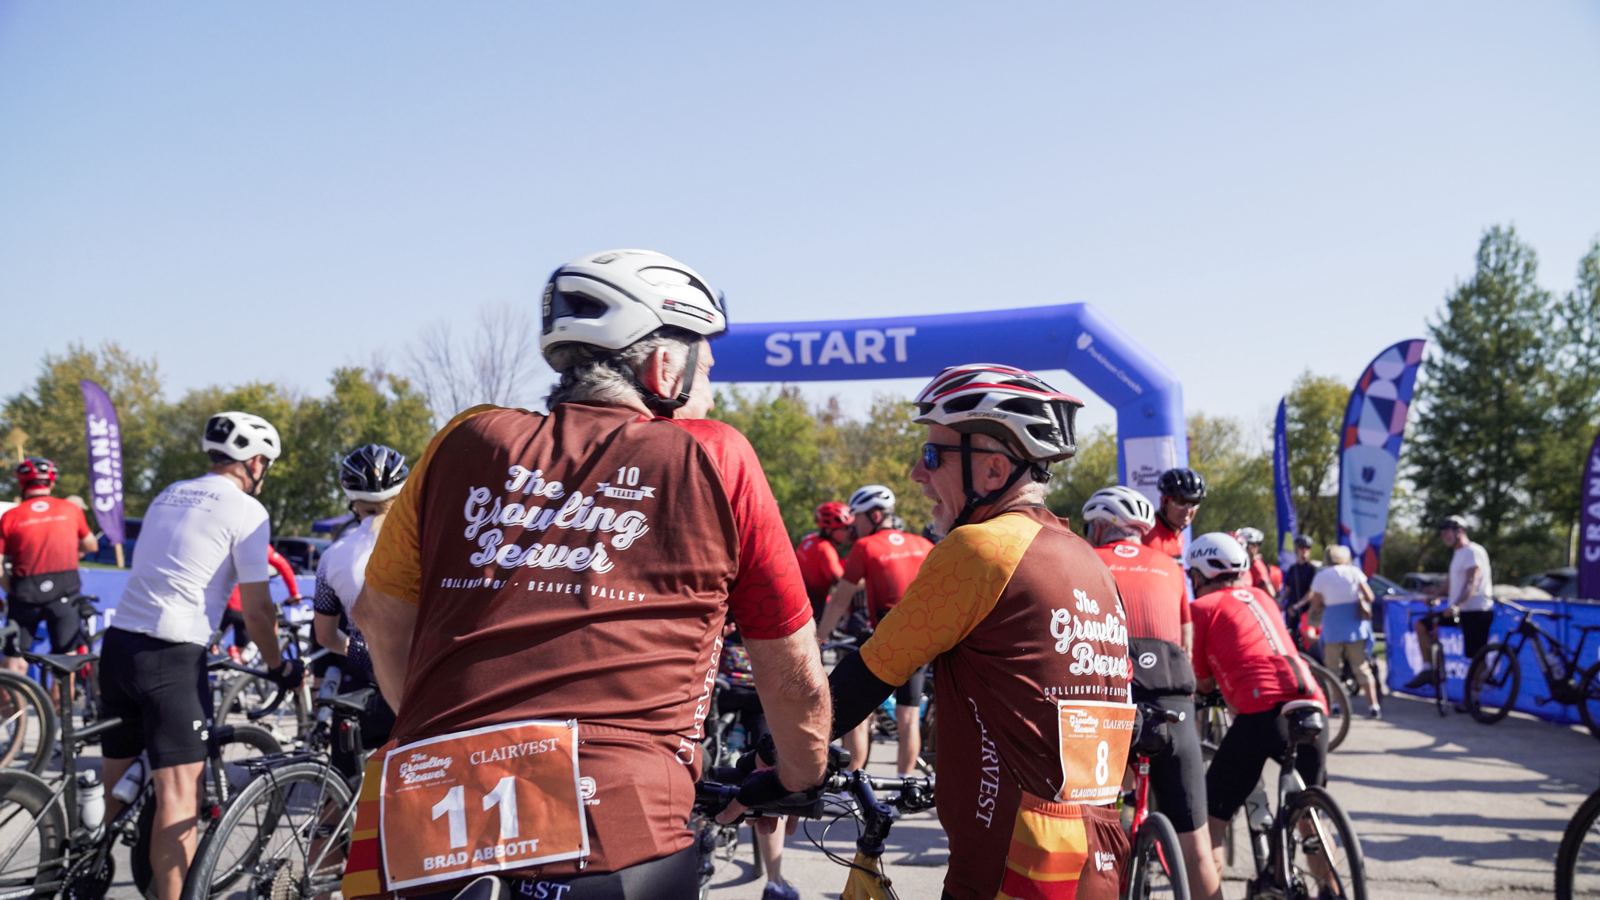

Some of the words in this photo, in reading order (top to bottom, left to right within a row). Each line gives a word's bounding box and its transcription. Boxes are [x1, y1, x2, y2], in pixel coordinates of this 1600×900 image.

[764, 327, 917, 367] START
[88, 417, 116, 512] CRANK
[616, 466, 640, 486] 10
[504, 464, 566, 500] The
[612, 489, 637, 499] YEARS
[463, 486, 650, 550] Growling
[469, 528, 616, 574] Beaver
[1190, 547, 1218, 559] KASK
[527, 580, 582, 595] BEAVER
[590, 585, 646, 602] VALLEY
[1072, 588, 1100, 615] The
[1044, 685, 1103, 696] COLLINGWOO
[193, 719, 203, 731] P
[200, 730, 209, 741] S
[470, 737, 560, 766] CLAIRVEST
[1095, 740, 1109, 786] 8
[431, 775, 520, 850] 11
[423, 852, 469, 872] BRAD
[471, 838, 540, 863] ABBOTT
